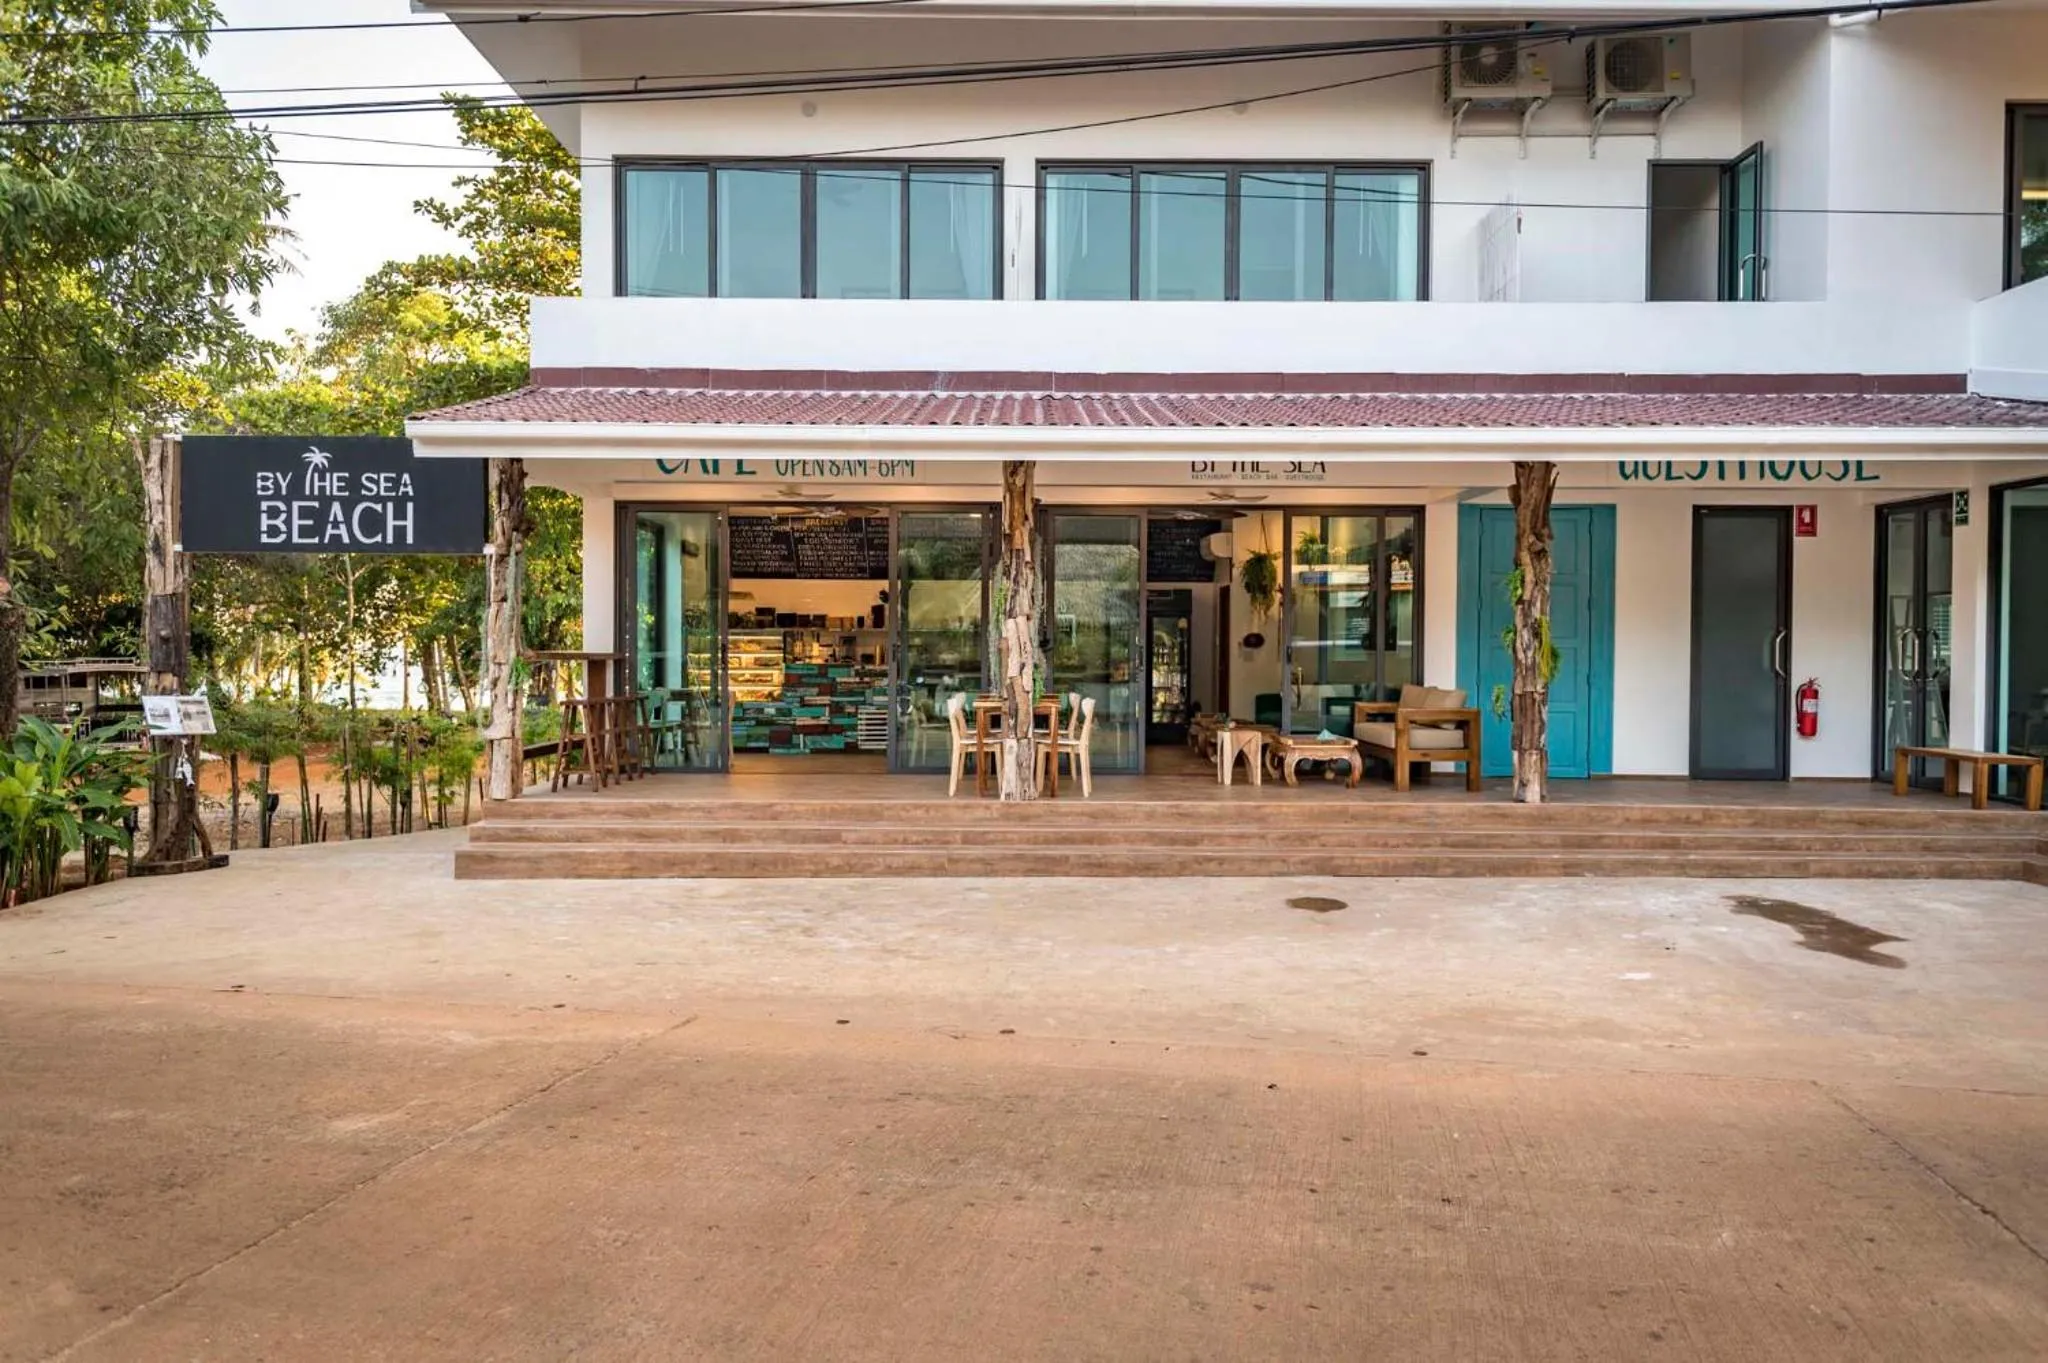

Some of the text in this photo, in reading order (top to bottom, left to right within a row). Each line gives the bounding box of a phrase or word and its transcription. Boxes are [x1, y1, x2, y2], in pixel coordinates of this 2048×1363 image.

[256, 472, 292, 496] BY
[361, 472, 414, 496] SEA
[260, 501, 414, 545] BEACH
